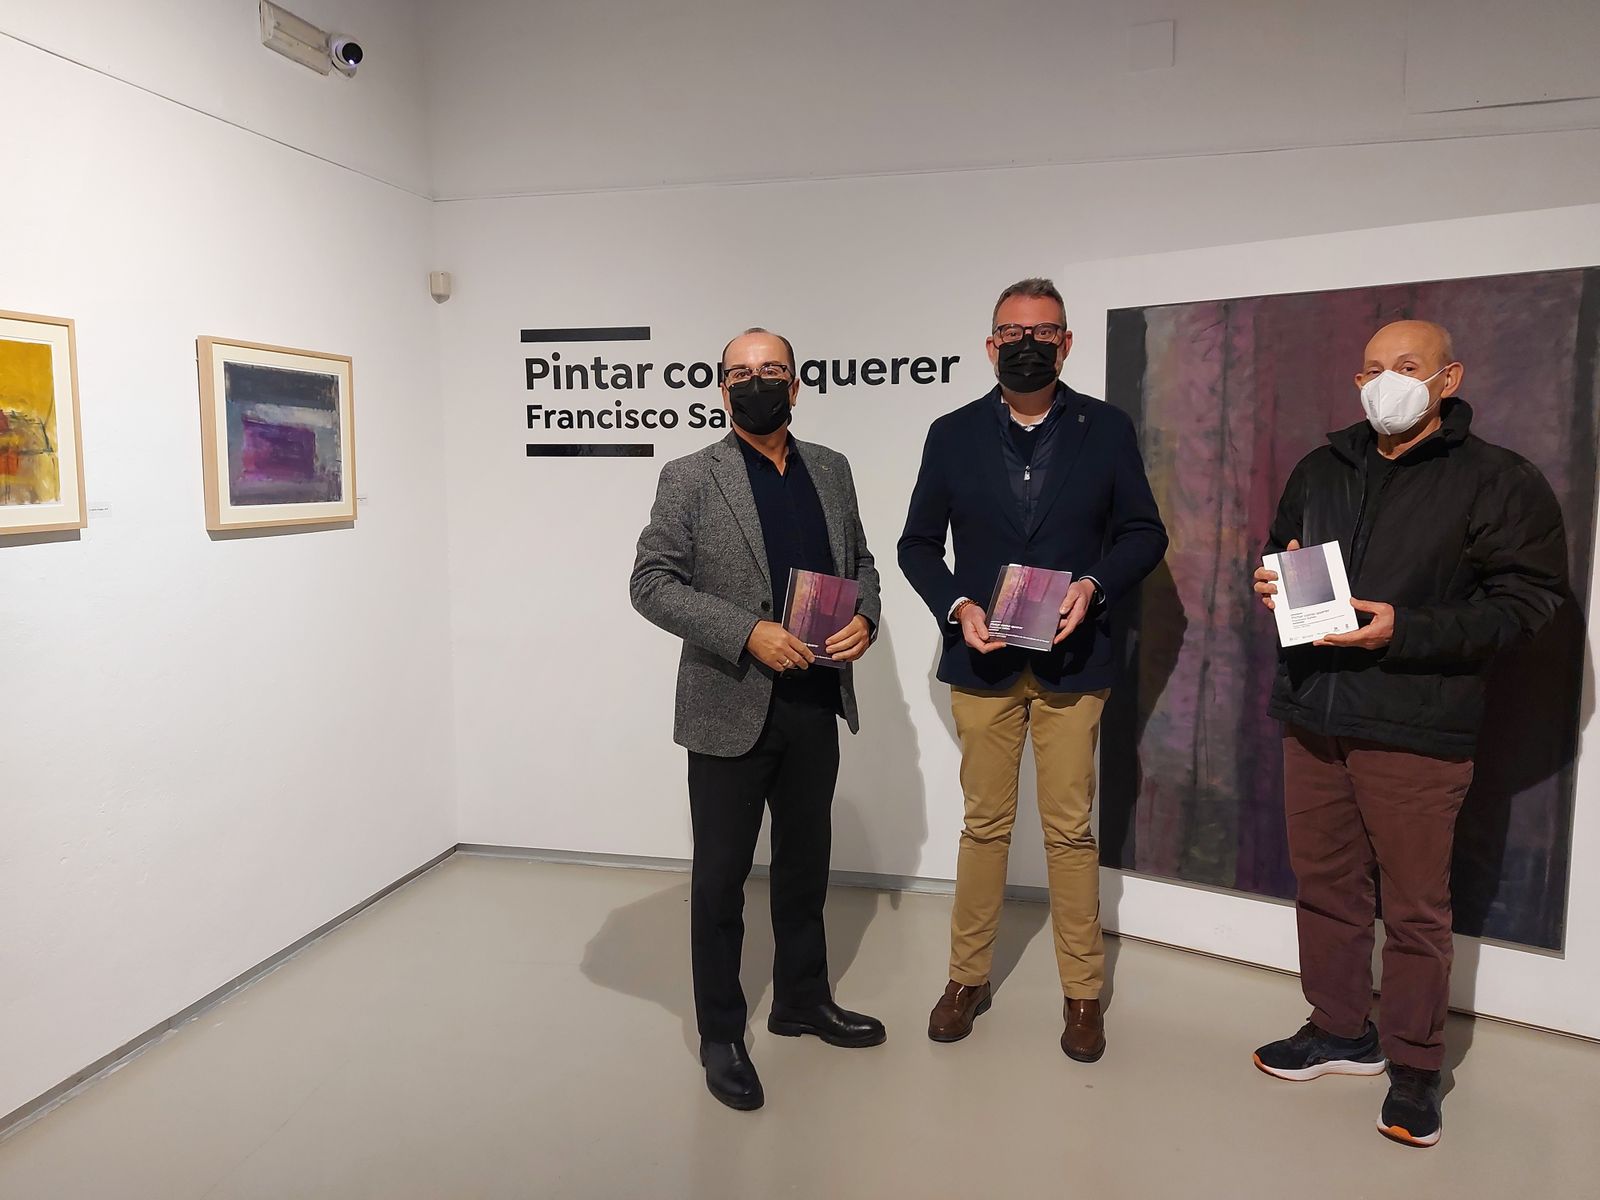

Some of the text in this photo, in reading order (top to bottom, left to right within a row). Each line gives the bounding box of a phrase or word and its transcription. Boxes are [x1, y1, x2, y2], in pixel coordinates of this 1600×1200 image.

[525, 351, 961, 395] Pintar co querer
[526, 400, 732, 430] Francisco Sa
